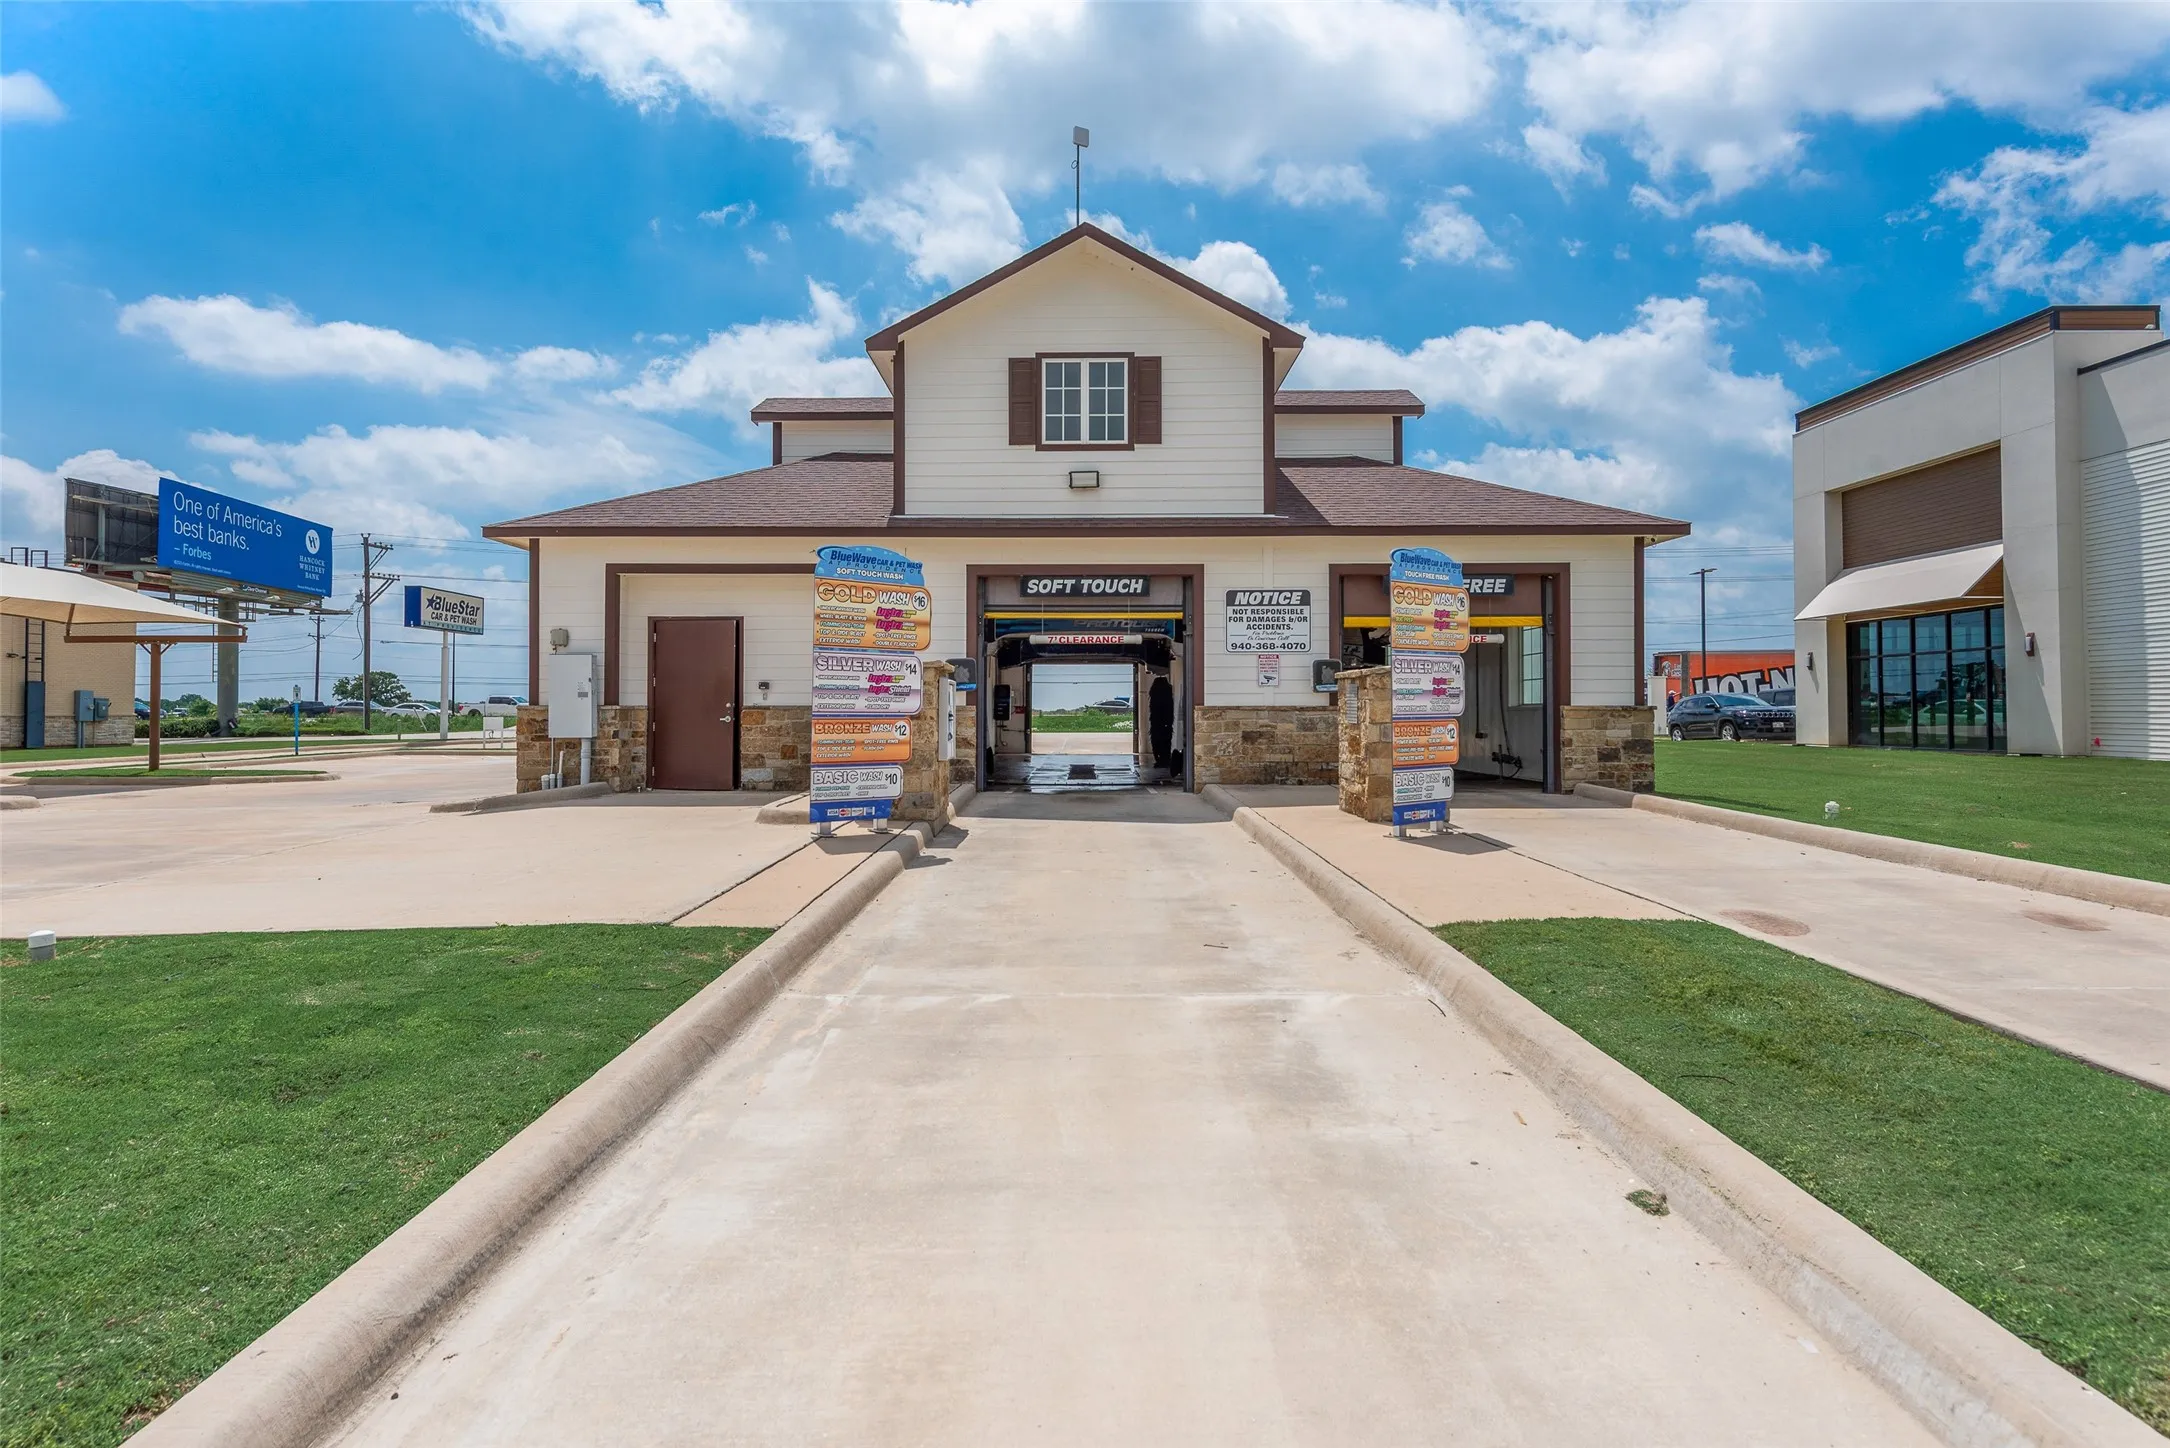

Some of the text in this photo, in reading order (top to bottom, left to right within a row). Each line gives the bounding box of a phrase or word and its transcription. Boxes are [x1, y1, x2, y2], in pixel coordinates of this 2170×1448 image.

[174, 492, 282, 538] One of America's
[174, 515, 250, 550] best banks.
[183, 544, 212, 560] Forbes
[1400, 552, 1431, 566] BlueWave
[300, 555, 325, 566] HANCOCK
[830, 550, 876, 566] BlueWave
[906, 561, 922, 570] WASH
[300, 562, 325, 574] WHITNEY
[858, 569, 882, 578] TOUCH
[883, 572, 904, 580] WASH
[1405, 570, 1422, 578] TOUCH
[304, 572, 320, 580] BANK
[1027, 579, 1143, 594] SOFT TOUCH
[818, 582, 926, 608] GOLD WASH $16
[1234, 592, 1302, 605] NOTICE
[1393, 586, 1432, 606] GOLD
[1433, 592, 1454, 606] WASH
[433, 596, 480, 617] BlueStar
[431, 612, 478, 626] CAR & PET WASH
[1048, 636, 1124, 644] 7' CLEARANCE
[1231, 642, 1306, 650] 940-368-4070
[816, 655, 918, 675] SILVER WASH $14
[1394, 658, 1432, 674] SILVER
[1432, 662, 1450, 673] WASH
[815, 722, 907, 736] BRONZE WASH $12
[1394, 725, 1456, 739] BRONZE WASH $12
[813, 770, 898, 785] BASIC WASH $10
[1395, 773, 1450, 787] BASIC WASH $10
